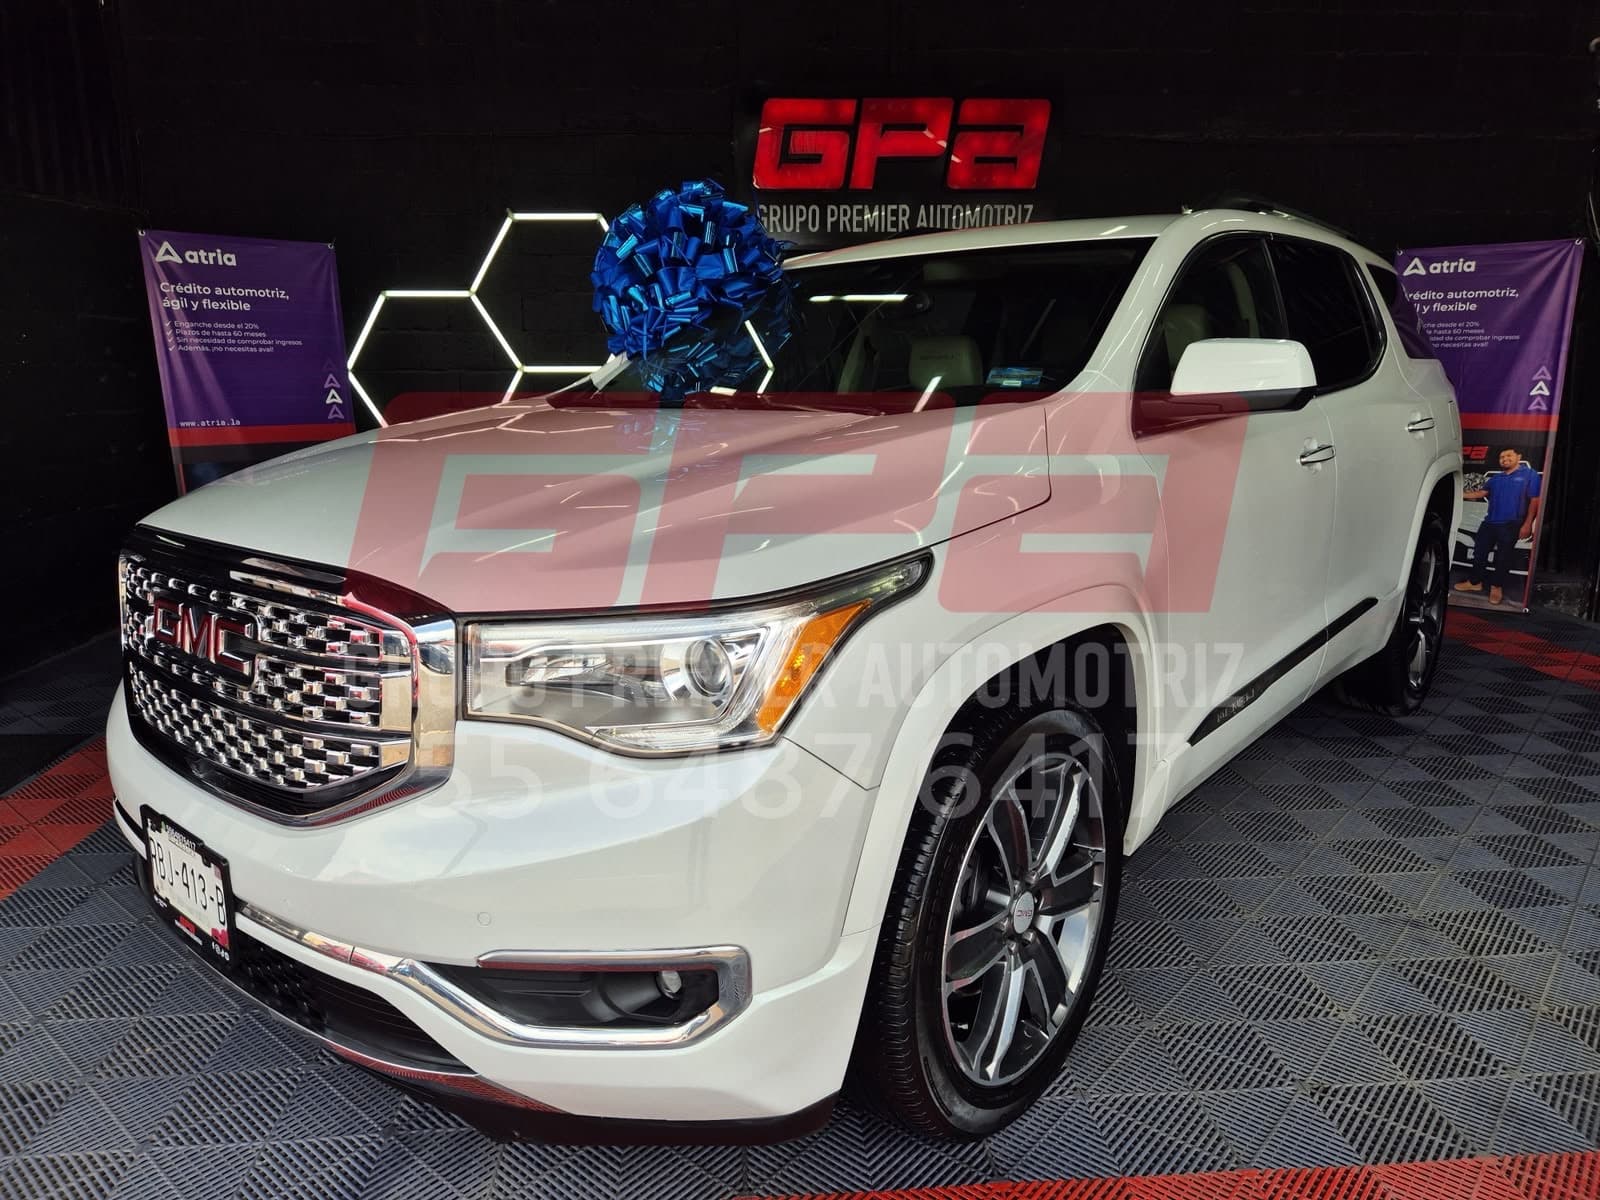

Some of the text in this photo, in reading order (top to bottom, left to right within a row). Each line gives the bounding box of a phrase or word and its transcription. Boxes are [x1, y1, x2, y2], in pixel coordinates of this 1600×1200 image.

[758, 203, 1034, 233] GRUPO PREMIER AUTOMOTRIZ
[185, 248, 237, 267] atria
[1429, 259, 1476, 274] atria
[160, 281, 290, 301] Crédito automotriz,
[1408, 287, 1520, 301] rédito automotriz,
[162, 296, 252, 311] ágil y flexible
[1421, 304, 1430, 315] y
[1432, 301, 1478, 312] flexible
[174, 320, 260, 330] Enganche desde el 20%
[1452, 327, 1462, 335] 60
[1465, 320, 1481, 328] 20%
[175, 328, 201, 337] Plazos
[201, 329, 211, 337] de
[211, 329, 232, 337] hasta
[232, 330, 243, 338] 60
[226, 337, 236, 345] de
[224, 345, 258, 353] necesitas
[179, 418, 241, 428] www.atria.la
[153, 598, 253, 677] GMC
[150, 837, 226, 926] RBJ-413-B
